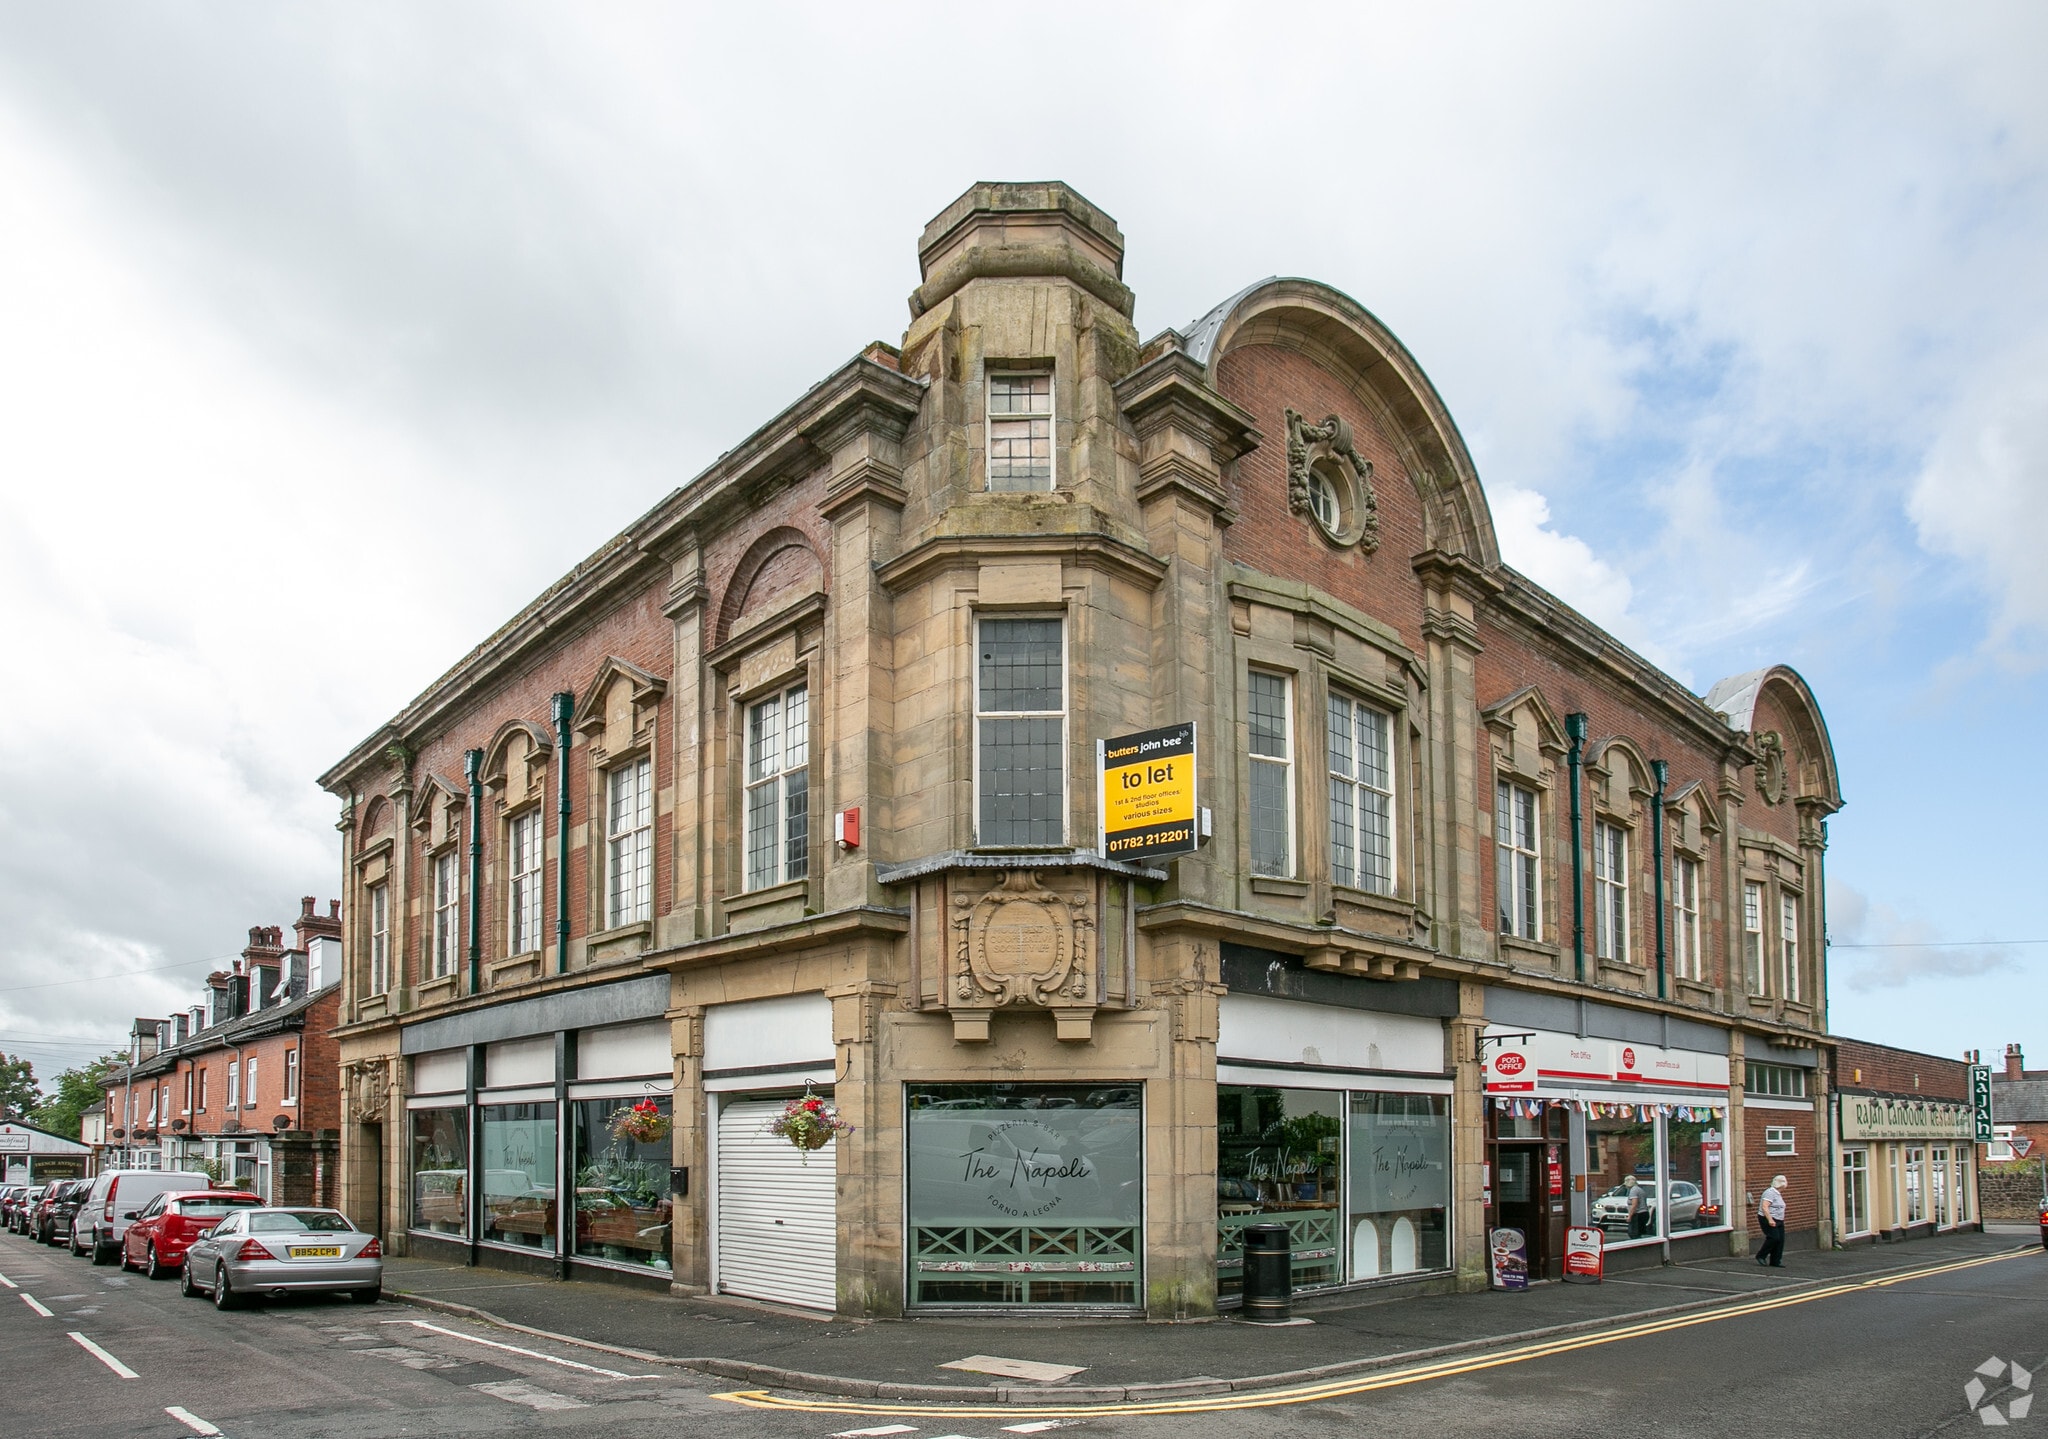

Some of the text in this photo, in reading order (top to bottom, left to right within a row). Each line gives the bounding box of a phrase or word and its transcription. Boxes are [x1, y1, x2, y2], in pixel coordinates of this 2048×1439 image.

[1108, 745, 1139, 758] butters
[1139, 740, 1160, 754] john
[1162, 737, 1182, 747] bee
[1122, 763, 1174, 789] to let
[1135, 800, 1160, 809] studios
[1142, 793, 1157, 801] floor
[1123, 807, 1172, 821] various sizes
[1110, 829, 1189, 851] 01782 212201
[1570, 1050, 1591, 1060] Post Office
[988, 1119, 1028, 1141] PIZZERIA
[1043, 1124, 1060, 1140] BAR
[959, 1147, 1091, 1188] The Napoli
[1245, 1146, 1317, 1184] The Napoli
[1372, 1145, 1429, 1179] The Napoli
[987, 1195, 1018, 1216] FORNO
[1033, 1196, 1062, 1216] LEGNA
[295, 1247, 337, 1256] BB52 CPB
